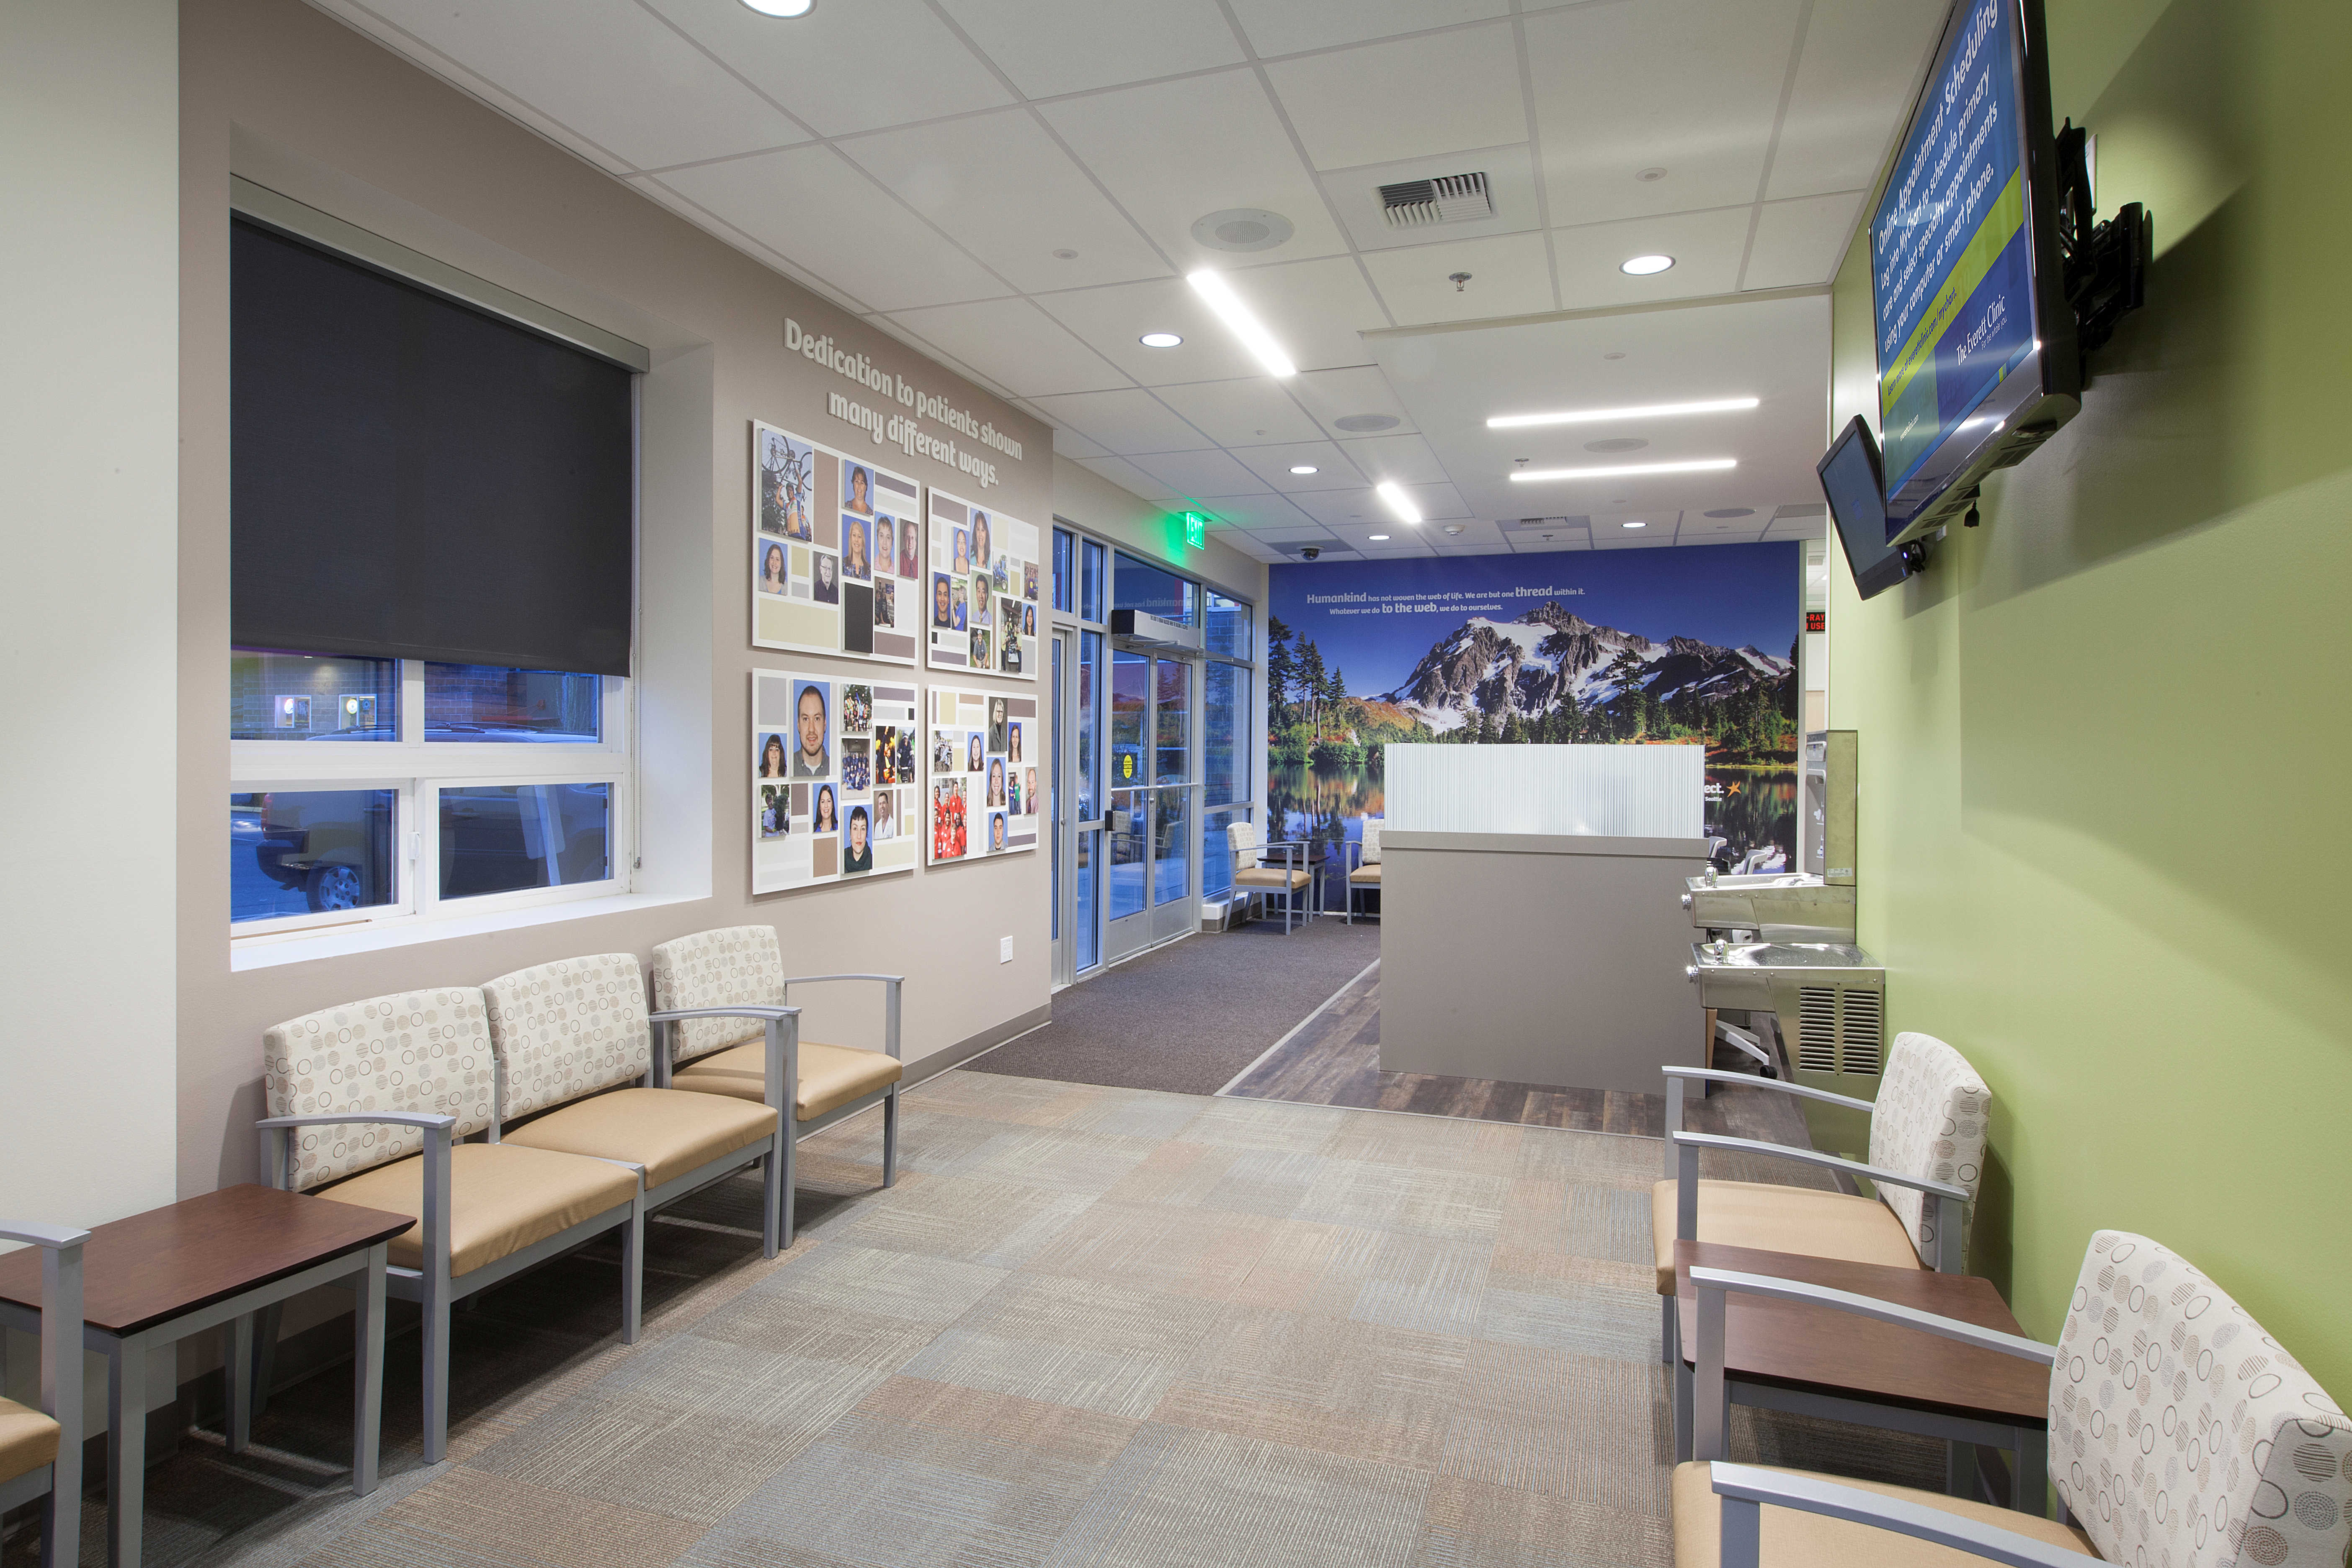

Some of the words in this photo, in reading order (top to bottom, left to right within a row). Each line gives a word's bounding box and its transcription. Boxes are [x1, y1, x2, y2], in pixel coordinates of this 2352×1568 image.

[1879, 207, 1898, 255] Online
[1899, 102, 1944, 217] Appointment
[1946, 0, 1998, 115] Scheduling
[1881, 268, 1890, 291] Log
[1890, 248, 1899, 273] into
[1900, 199, 1923, 255] MyChart
[1922, 188, 1929, 209] to
[1930, 129, 1957, 195] schedule
[1959, 64, 1990, 147] primary
[1883, 296, 1893, 321] care
[1893, 268, 1903, 303] and
[1903, 246, 1918, 285] select
[1919, 197, 1944, 258] specialty
[1946, 101, 1998, 207] appointments
[1885, 324, 1897, 352] using
[1897, 302, 1909, 338] your
[1910, 257, 1935, 311] computer
[1937, 242, 1944, 266] or
[1945, 203, 1965, 253] smart
[1966, 162, 1994, 223] phone.
[1956, 343, 1967, 366] The
[1967, 315, 1987, 354] Everett
[1987, 294, 2006, 328] Clinic
[784, 318, 892, 397] Dedication
[896, 374, 913, 406] to
[915, 391, 978, 439] patients
[980, 421, 1022, 460] shown
[1900, 413, 1919, 441] everettclinic.com
[828, 392, 883, 444] many
[886, 414, 956, 467] different
[959, 451, 999, 488] ways.
[1191, 517, 1203, 545] EXIT
[1307, 592, 1366, 603] Humankind
[1516, 586, 1552, 597] thread
[1382, 603, 1393, 613] to
[1395, 603, 1412, 613] the
[1414, 602, 1438, 613] web,
